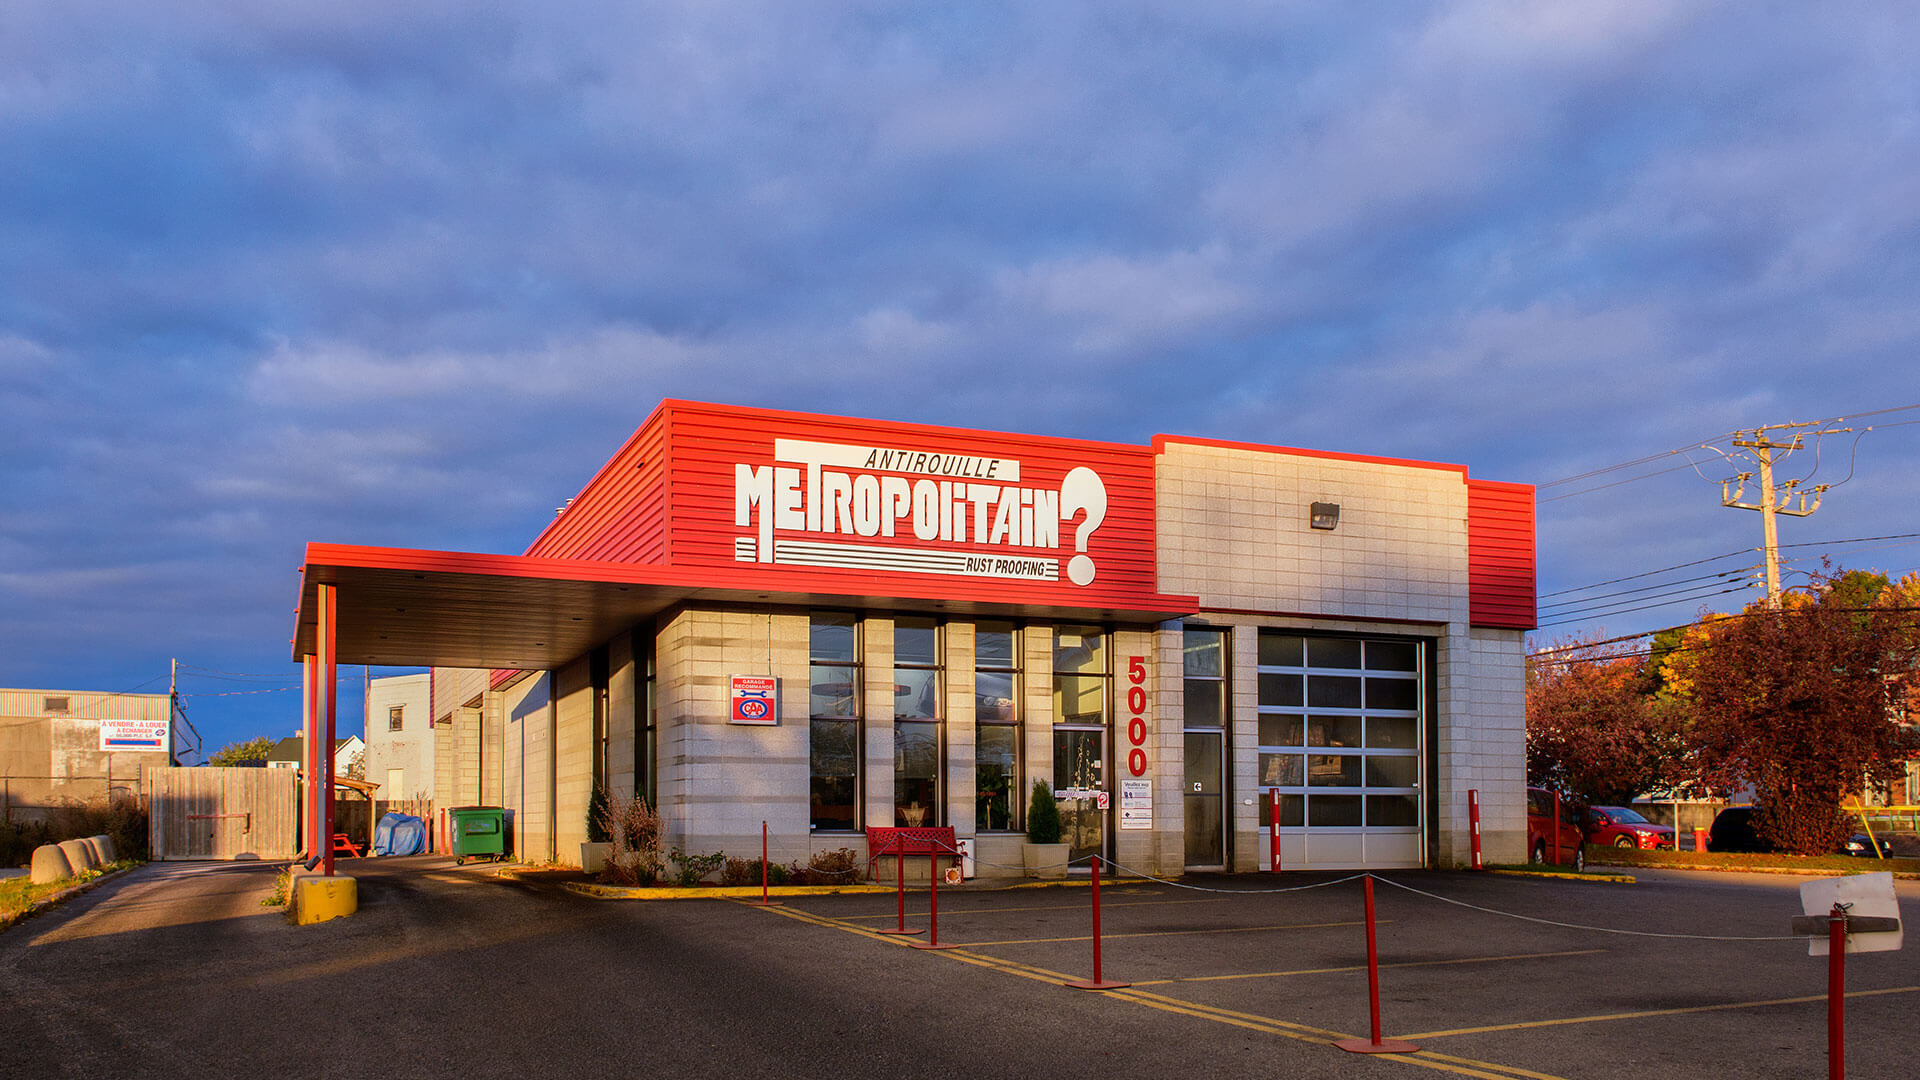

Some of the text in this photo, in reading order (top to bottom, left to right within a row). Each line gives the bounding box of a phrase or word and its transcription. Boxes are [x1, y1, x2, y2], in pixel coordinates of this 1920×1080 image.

[864, 448, 1000, 478] ANTIROUILLE
[966, 557, 1046, 577] RUST PROOFING
[744, 702, 763, 715] CAA
[1127, 655, 1148, 777] 5000
